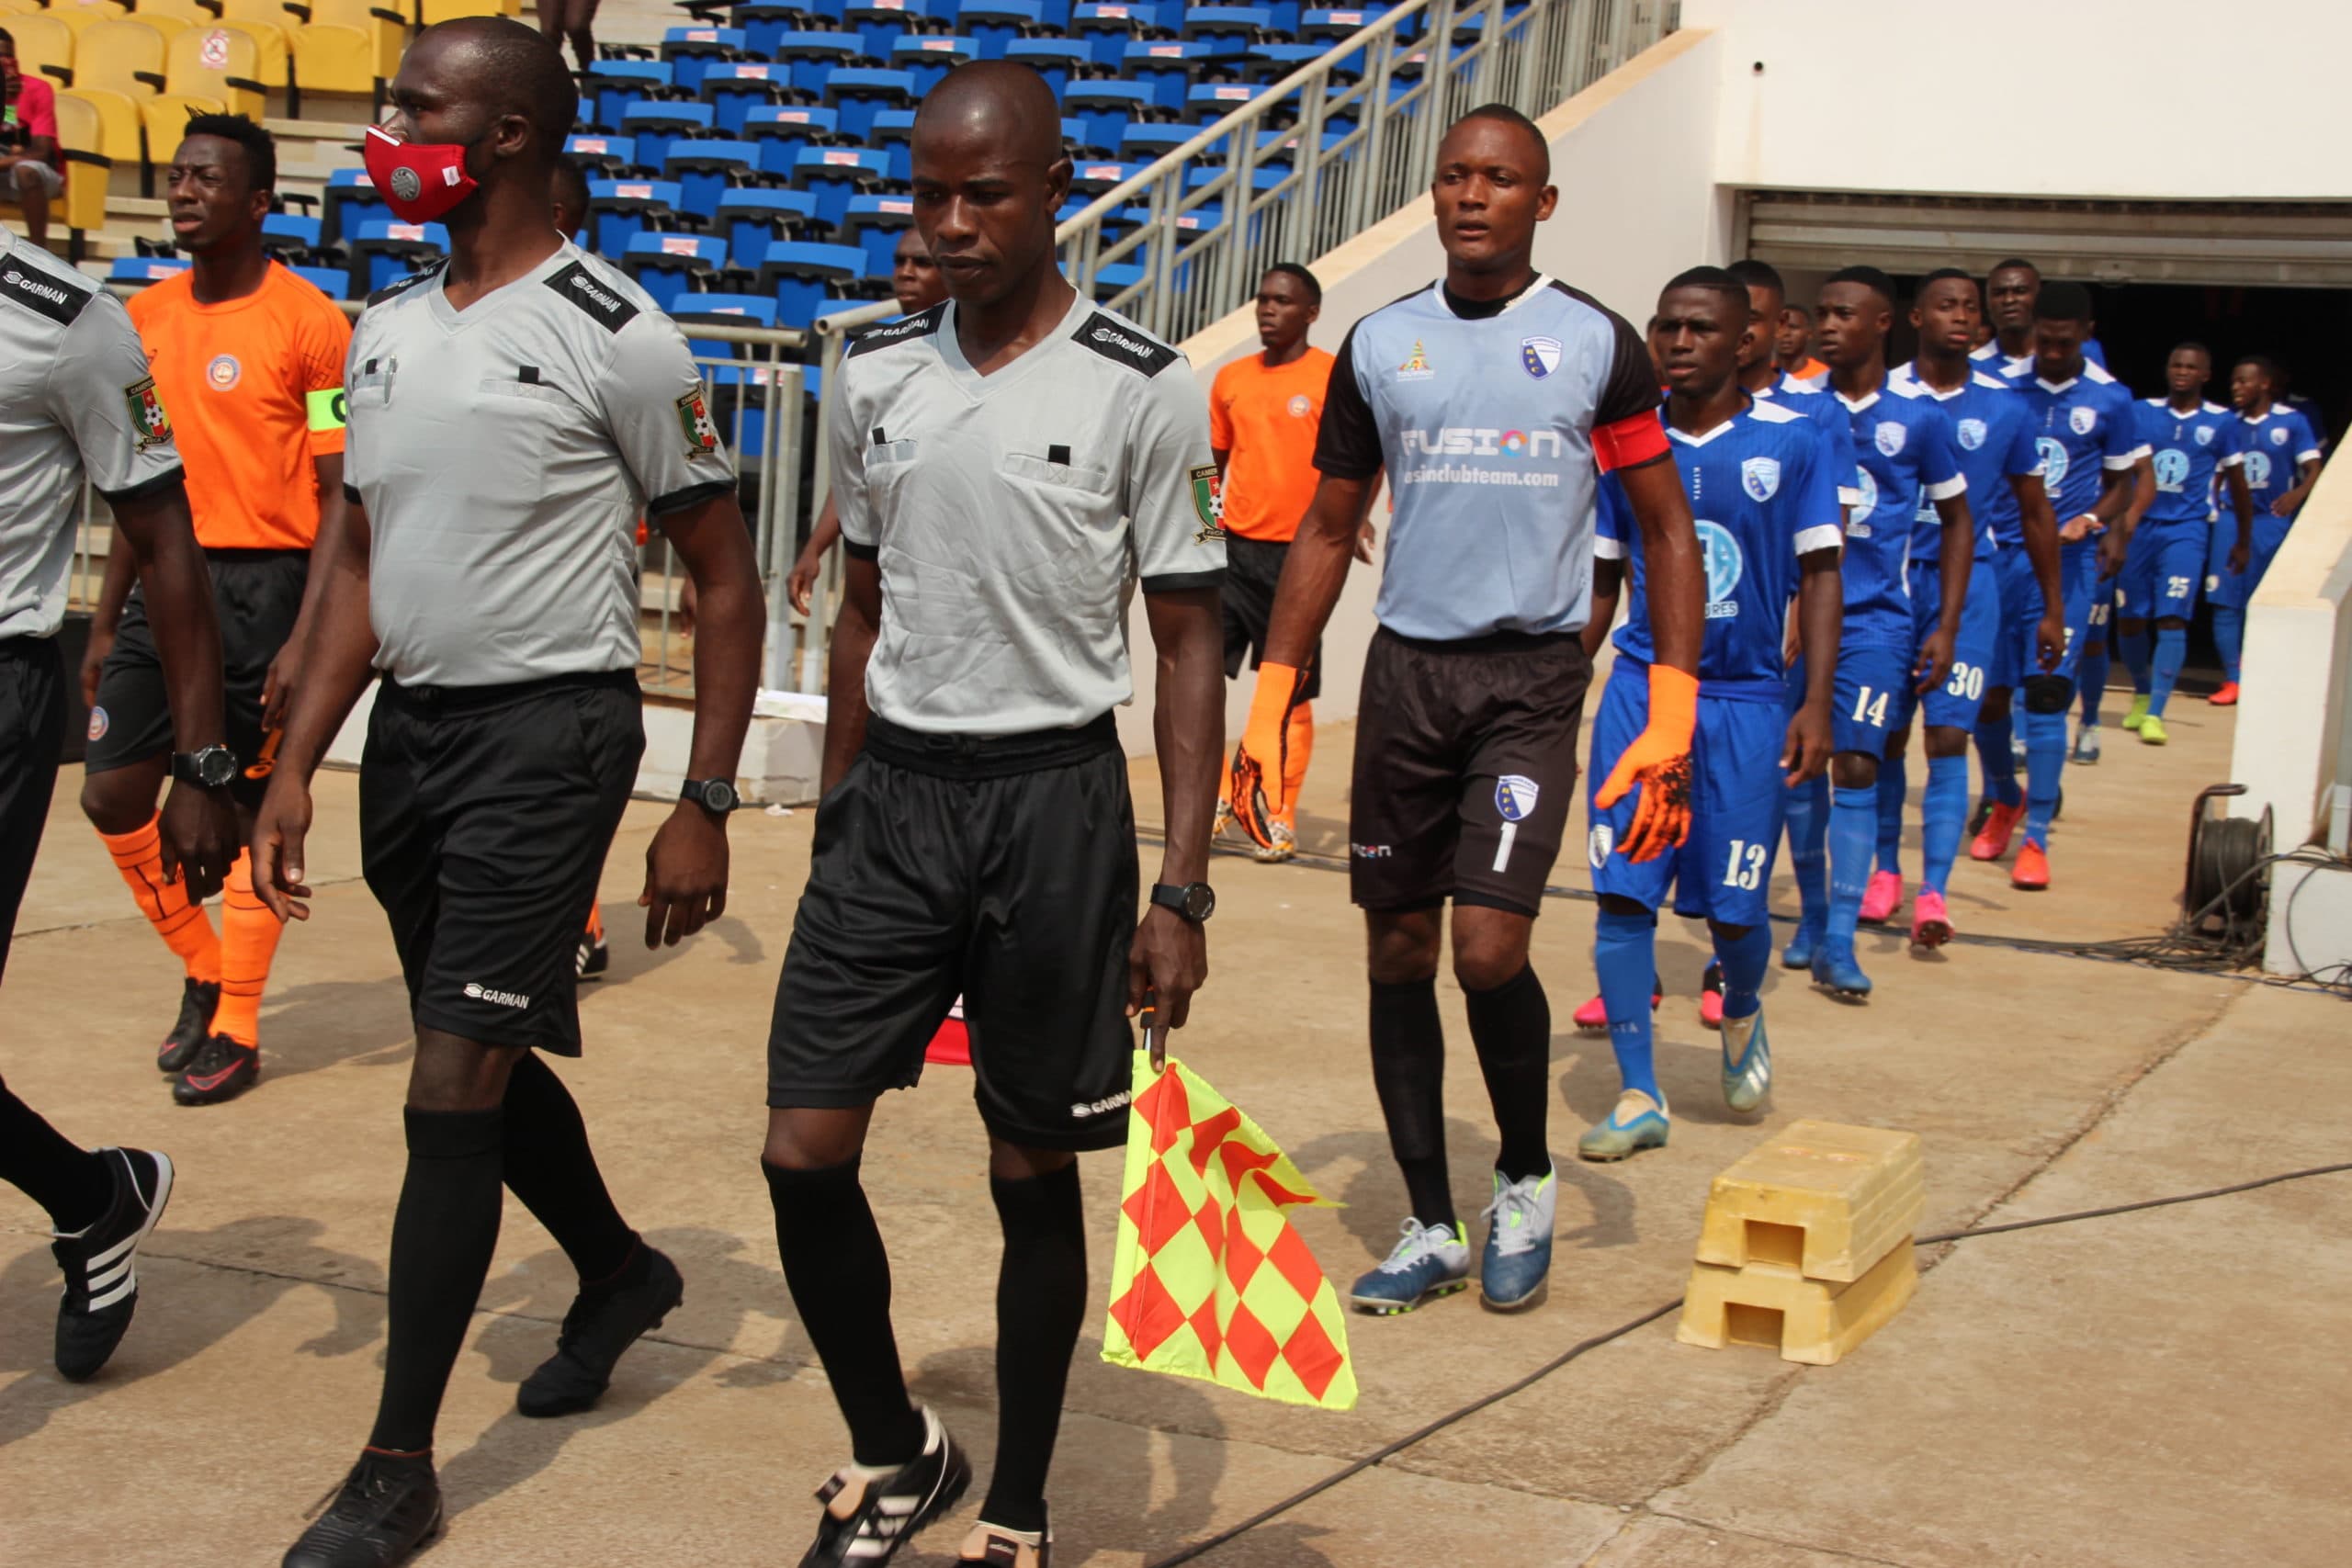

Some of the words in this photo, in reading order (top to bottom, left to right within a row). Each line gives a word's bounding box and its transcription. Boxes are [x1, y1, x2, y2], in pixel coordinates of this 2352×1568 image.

[20, 279, 68, 305] GARMAN
[583, 284, 621, 313] GARMAN
[1108, 333, 1154, 358] GARMAN
[1401, 428, 1561, 458] FUSION
[2166, 576, 2190, 599] 25
[1947, 661, 1984, 701] 30
[1851, 685, 1889, 728] 14
[1492, 821, 1518, 873] 1
[1723, 840, 1767, 891] 13
[482, 989, 530, 1010] GARMAN
[1091, 1089, 1132, 1113] GARMA
